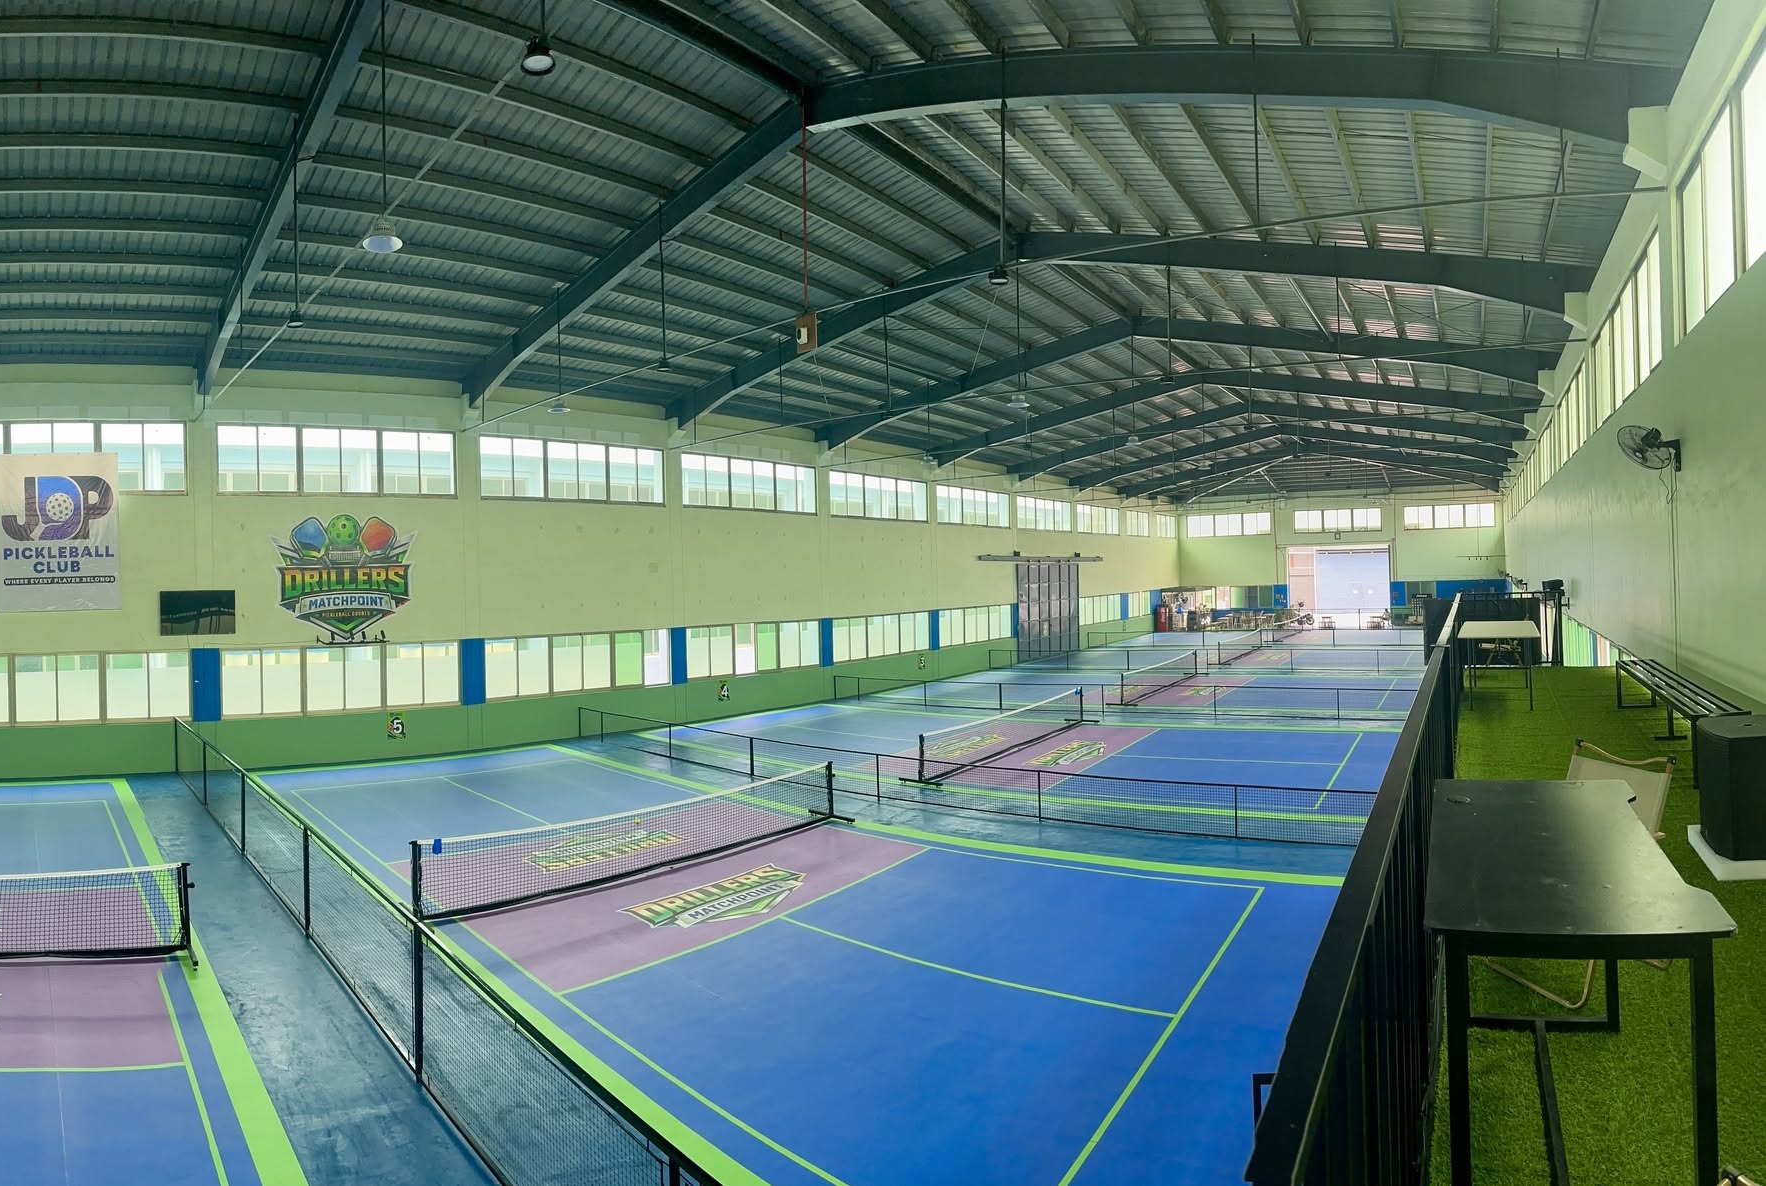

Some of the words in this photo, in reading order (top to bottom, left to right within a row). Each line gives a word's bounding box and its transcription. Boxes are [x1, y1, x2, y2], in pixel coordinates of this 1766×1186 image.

[3, 545, 115, 560] PICKLEBALL
[33, 560, 81, 574] CLUB
[283, 566, 406, 599] DRILLERS
[308, 596, 384, 610] MATCHPOINT
[721, 685, 729, 697] 4
[393, 719, 403, 734] 5
[633, 867, 794, 923] DRILLERS
[688, 883, 785, 921] MATCHPOINT
